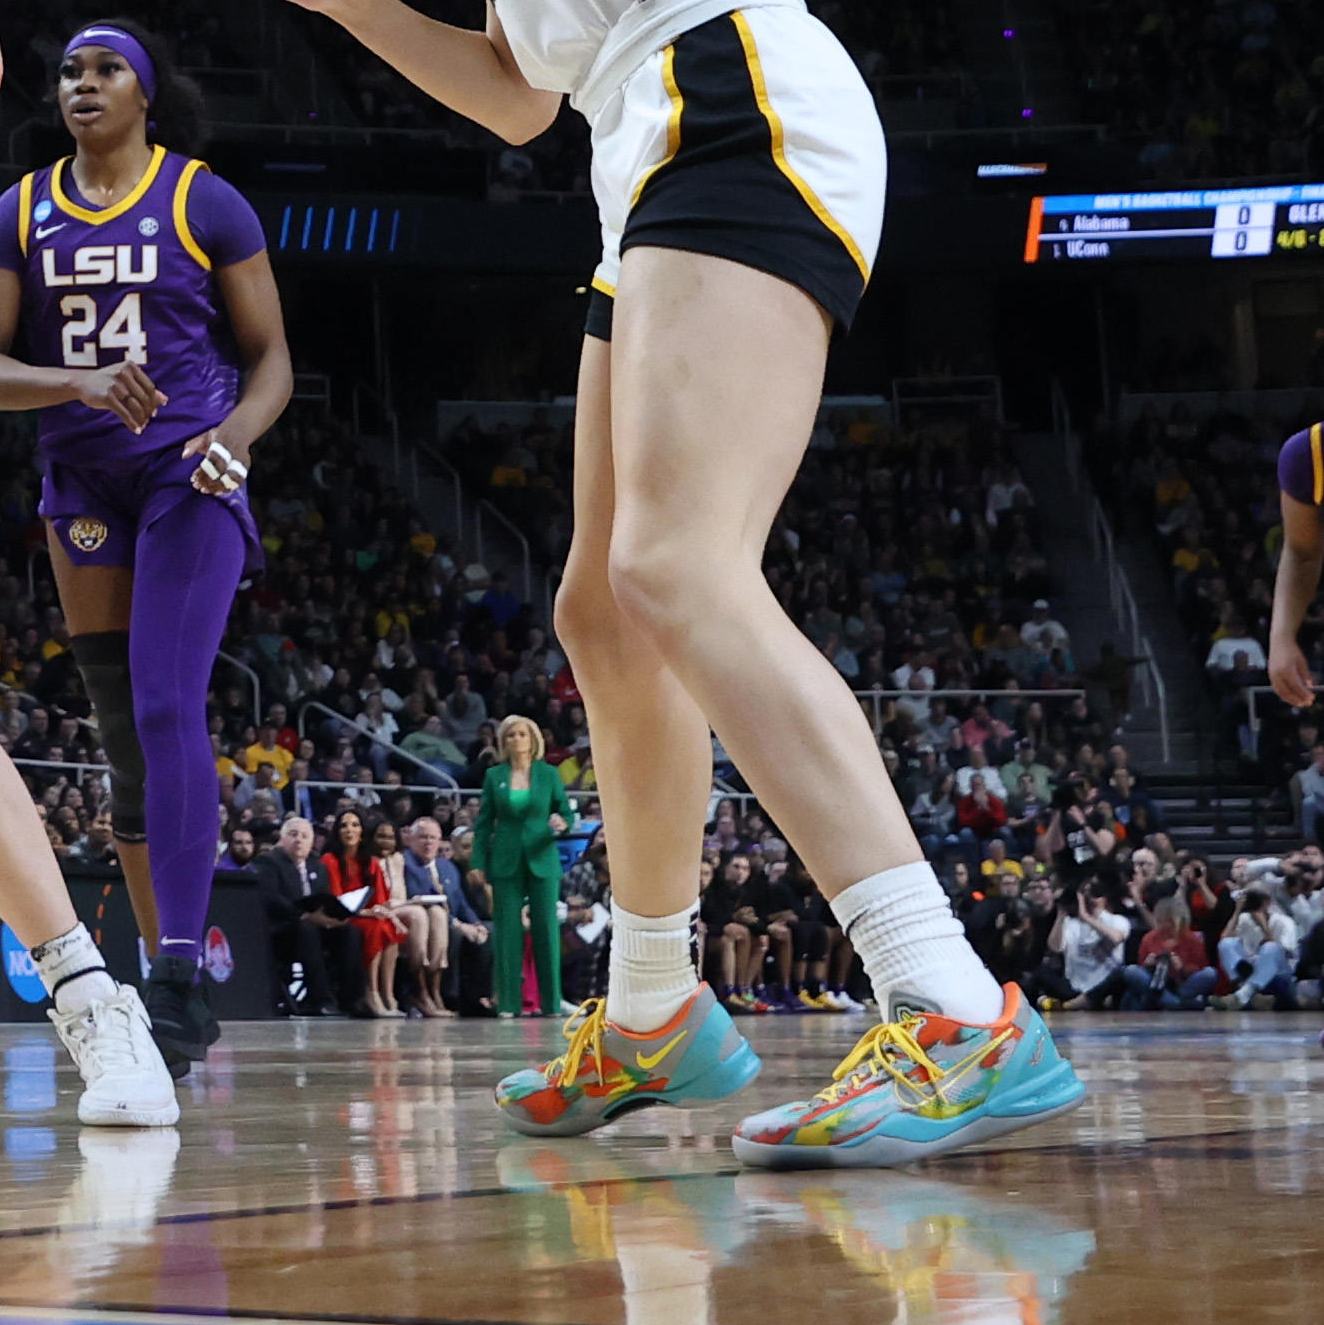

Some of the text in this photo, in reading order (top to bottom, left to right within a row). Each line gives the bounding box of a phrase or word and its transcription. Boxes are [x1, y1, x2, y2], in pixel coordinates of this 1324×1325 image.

[1073, 214, 1130, 231] Alabama
[1238, 205, 1250, 226] 0
[1067, 239, 1109, 257] UConn
[1235, 231, 1247, 251] 0
[42, 245, 158, 287] LSU
[59, 293, 147, 367] 24
